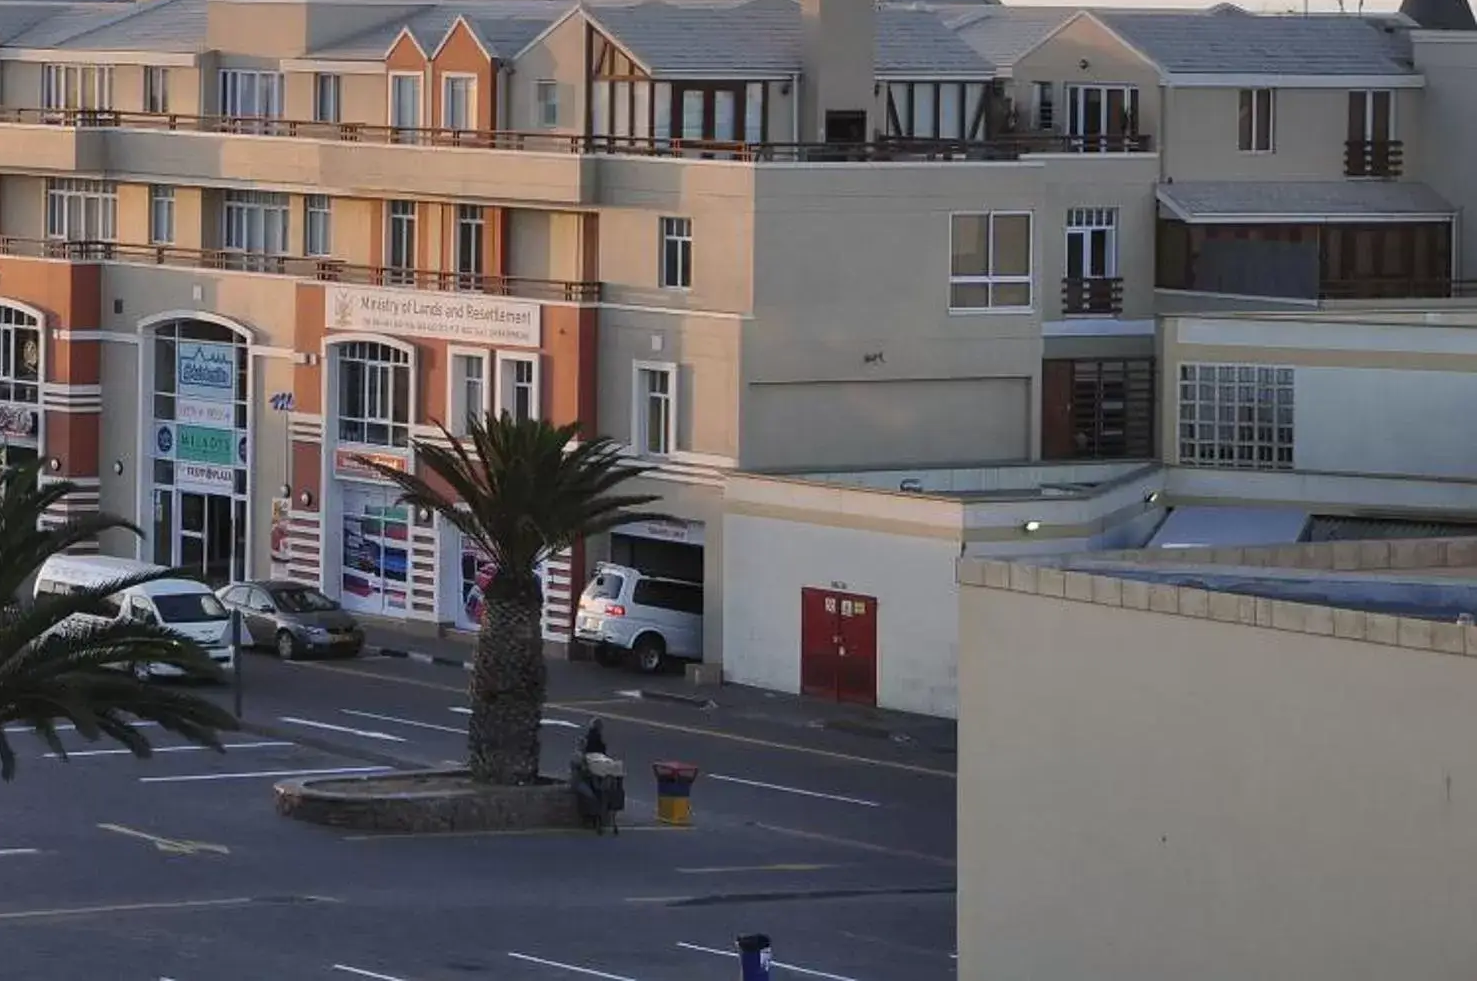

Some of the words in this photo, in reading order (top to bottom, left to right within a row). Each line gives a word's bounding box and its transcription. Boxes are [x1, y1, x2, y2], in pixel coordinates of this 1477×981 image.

[360, 296, 399, 315] Ministry
[402, 299, 412, 314] of
[414, 300, 442, 317] Lands
[446, 304, 463, 319] and
[467, 304, 531, 325] Resettlement
